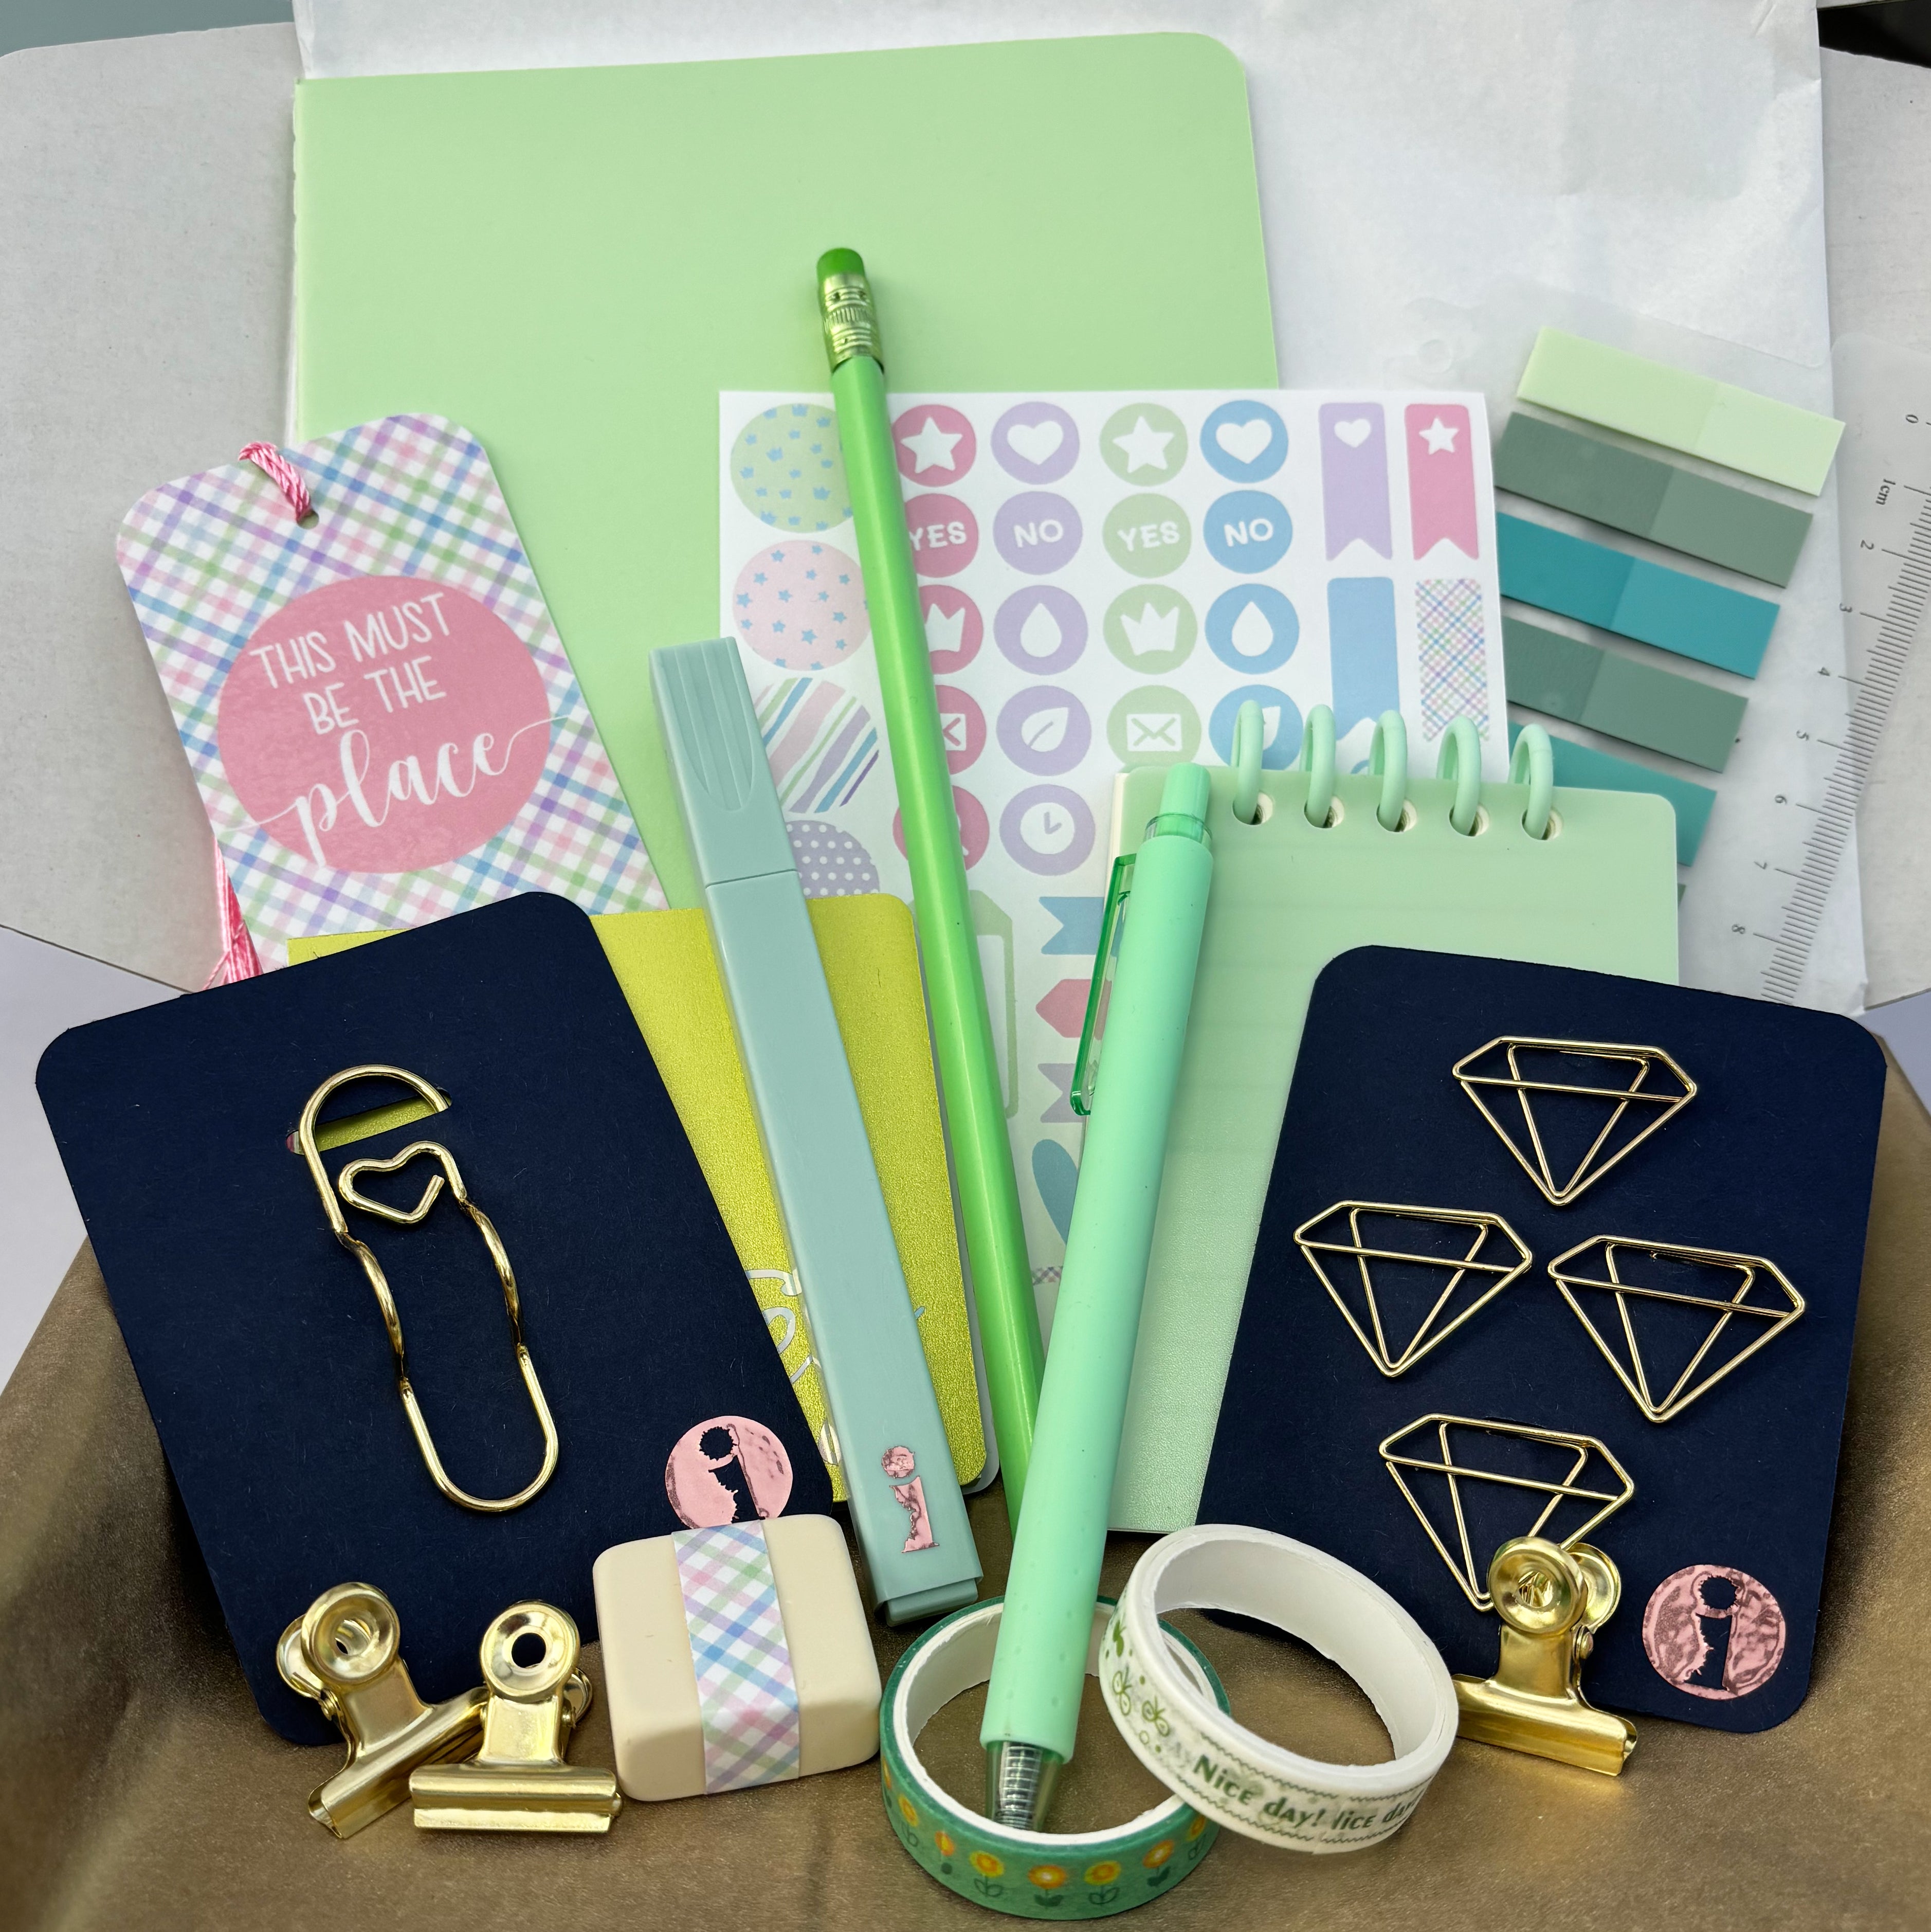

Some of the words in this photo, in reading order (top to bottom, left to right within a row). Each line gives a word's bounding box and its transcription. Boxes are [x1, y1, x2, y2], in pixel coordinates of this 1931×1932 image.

[1875, 478, 1896, 505] 1cm
[908, 521, 967, 551] YES
[1013, 519, 1064, 548] NO
[1118, 521, 1180, 552] YES
[1224, 518, 1273, 547] NO
[1860, 539, 1874, 550] 2
[1839, 602, 1853, 613] 3
[250, 631, 337, 688] THIS
[344, 592, 449, 662] MUST
[1817, 666, 1830, 676] 4
[302, 682, 359, 734] BE
[364, 655, 446, 713] THE
[1796, 729, 1810, 741] 5
[225, 714, 570, 868] place
[1754, 861, 1768, 870] 7
[1731, 924, 1746, 934] 8
